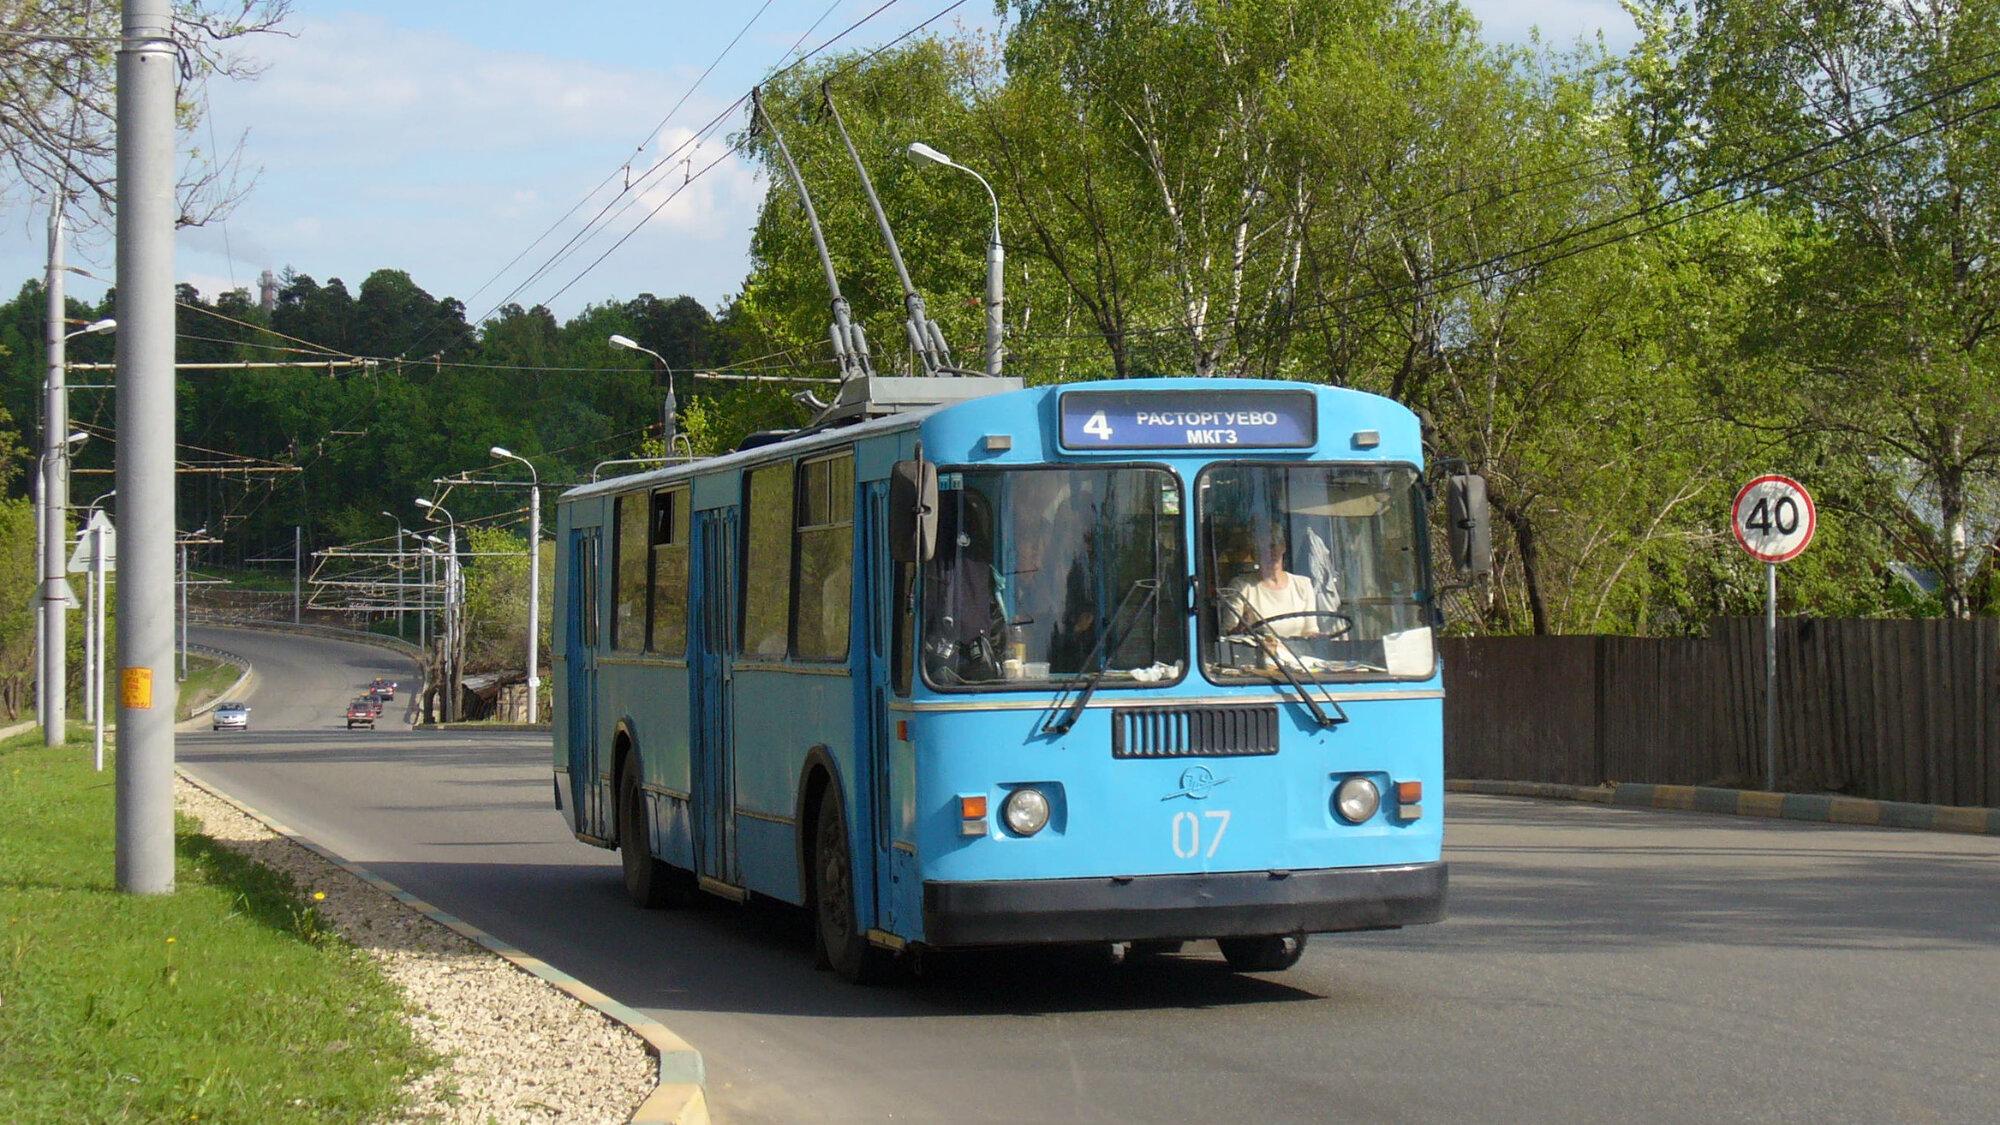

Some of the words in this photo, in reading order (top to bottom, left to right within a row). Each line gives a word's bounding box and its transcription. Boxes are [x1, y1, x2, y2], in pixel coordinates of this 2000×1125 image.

[1083, 410, 1113, 440] 4
[1136, 411, 1278, 426] РАСТОРГУЕВО
[1745, 496, 1799, 536] 40
[1172, 810, 1231, 859] 07
